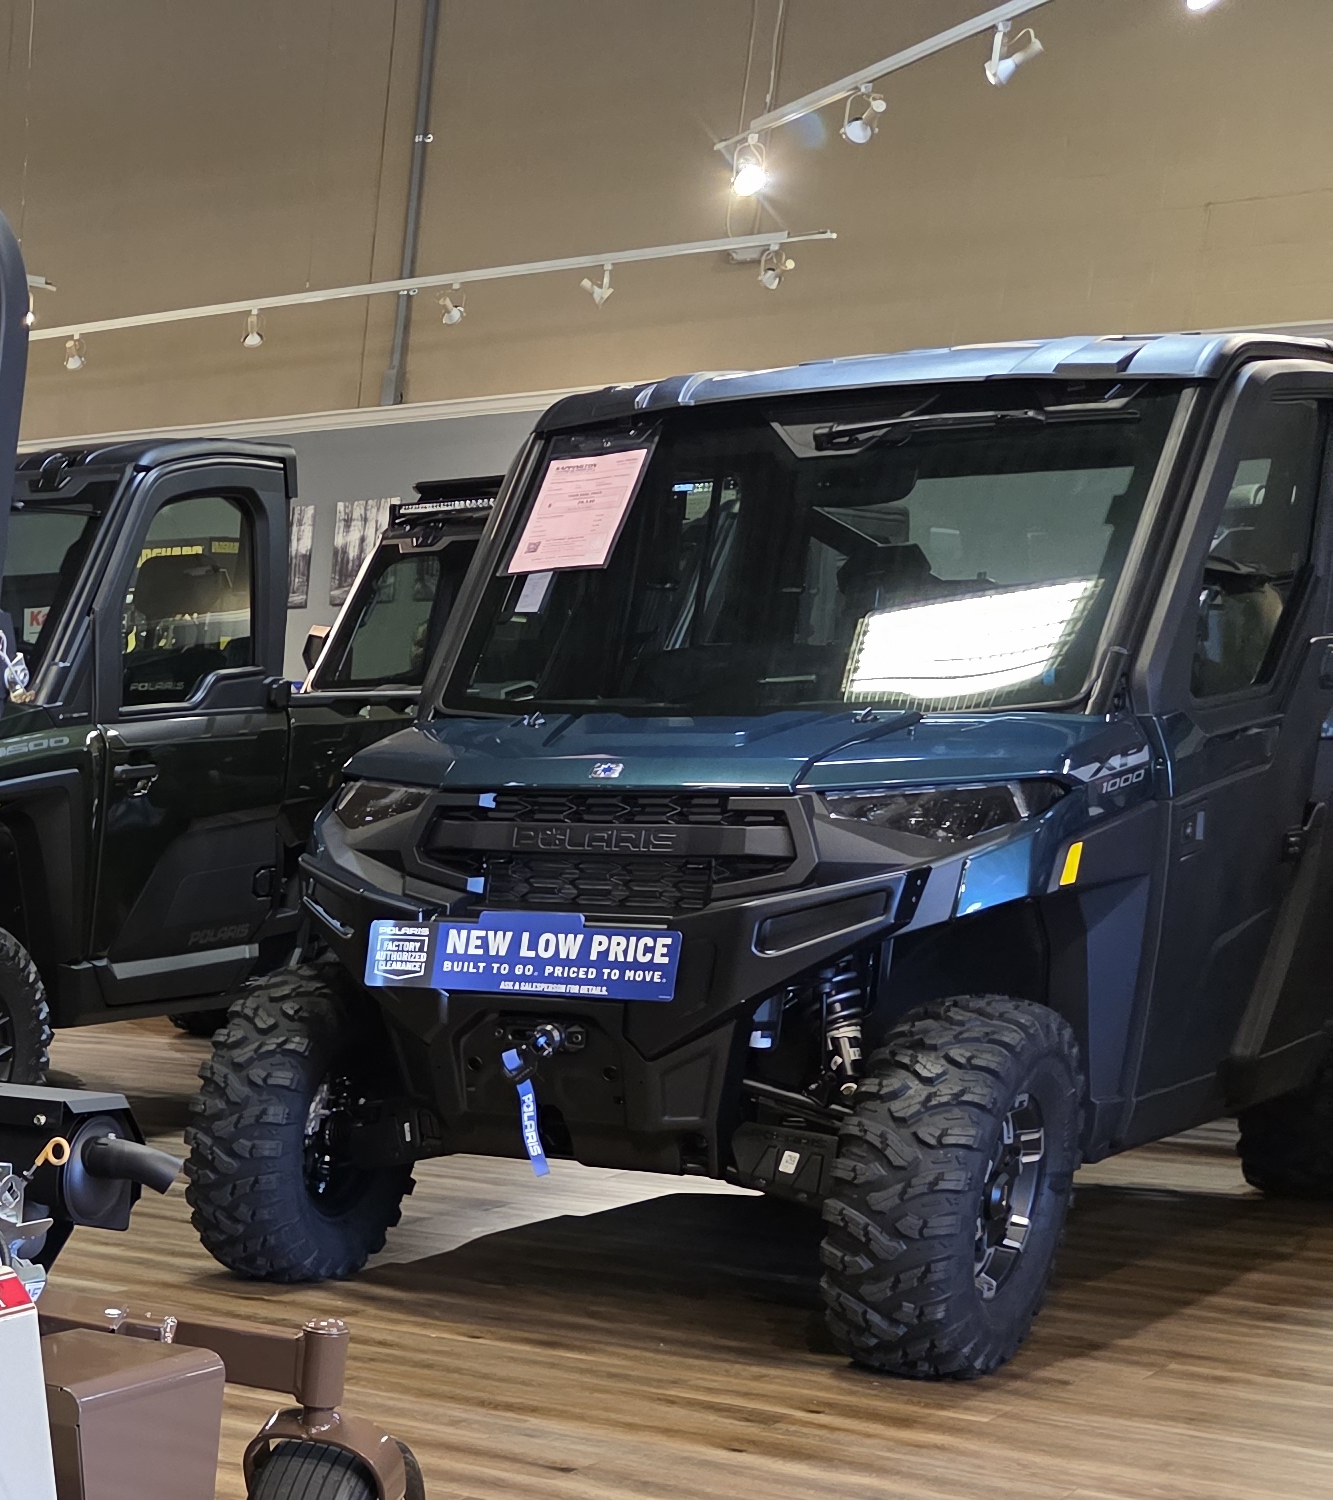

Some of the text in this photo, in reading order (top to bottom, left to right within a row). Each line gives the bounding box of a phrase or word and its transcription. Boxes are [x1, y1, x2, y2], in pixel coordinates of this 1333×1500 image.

[130, 681, 185, 692] POLARIS
[1102, 769, 1145, 794] 1000
[511, 825, 678, 853] POLARIS
[187, 922, 250, 946] POLARIS
[379, 926, 430, 936] POLARIS
[382, 941, 421, 952] FACTORY
[446, 928, 673, 964] NEW LOW PRICE
[375, 951, 427, 962] AUTHORIZED
[378, 961, 422, 972] CLEARANCE
[443, 960, 486, 973] BUILT
[492, 962, 510, 974] TO
[544, 965, 597, 979] PRICED
[602, 968, 620, 981] TO
[624, 970, 667, 984] MOVE.
[500, 980, 513, 990] ASK
[520, 981, 565, 993] SALESPERSON
[521, 1093, 542, 1157] POLARIS
